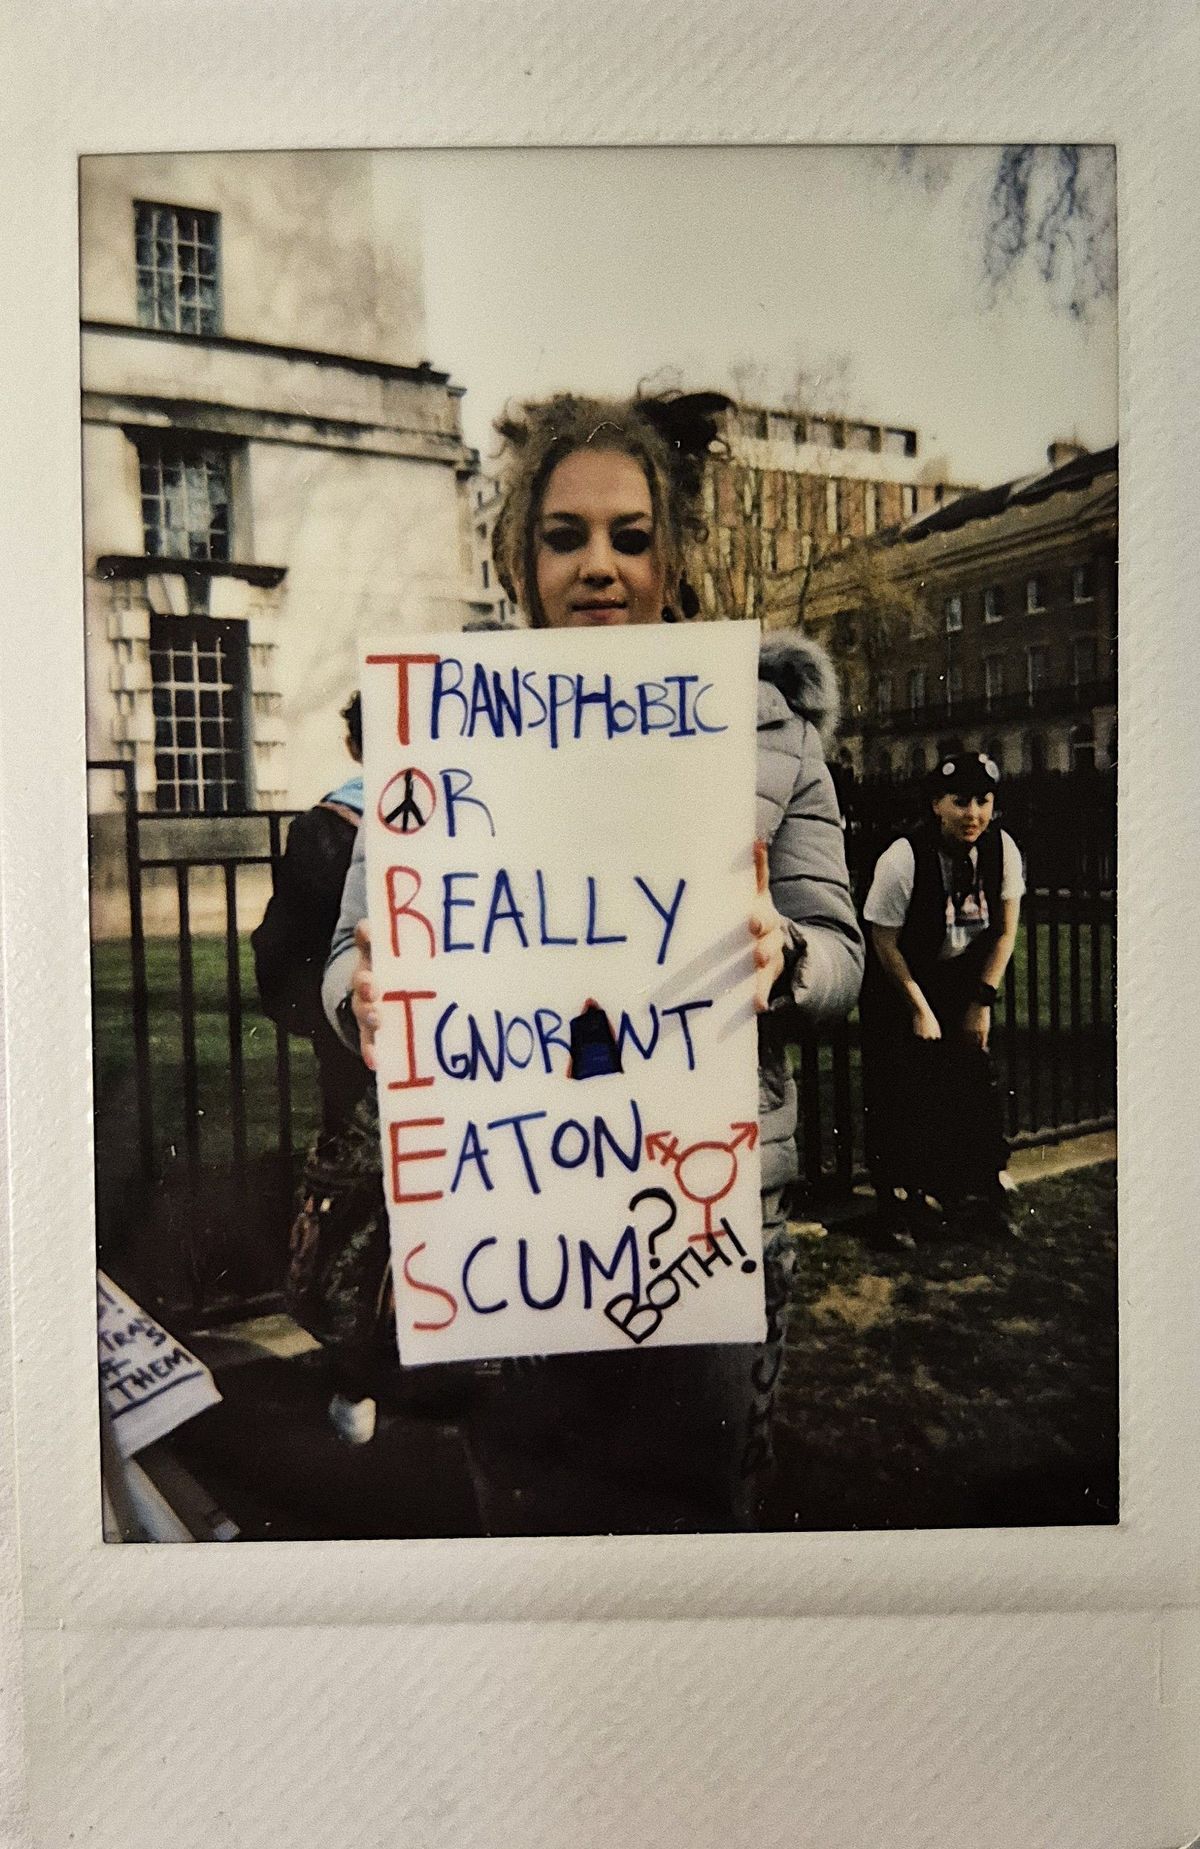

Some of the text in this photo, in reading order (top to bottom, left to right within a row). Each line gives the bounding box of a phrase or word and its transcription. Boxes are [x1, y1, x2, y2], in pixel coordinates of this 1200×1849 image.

[385, 865, 685, 965] REALLY
[382, 990, 713, 1090] IGNORNT
[388, 1099, 644, 1204] EATON
[107, 1346, 193, 1401] THEM
